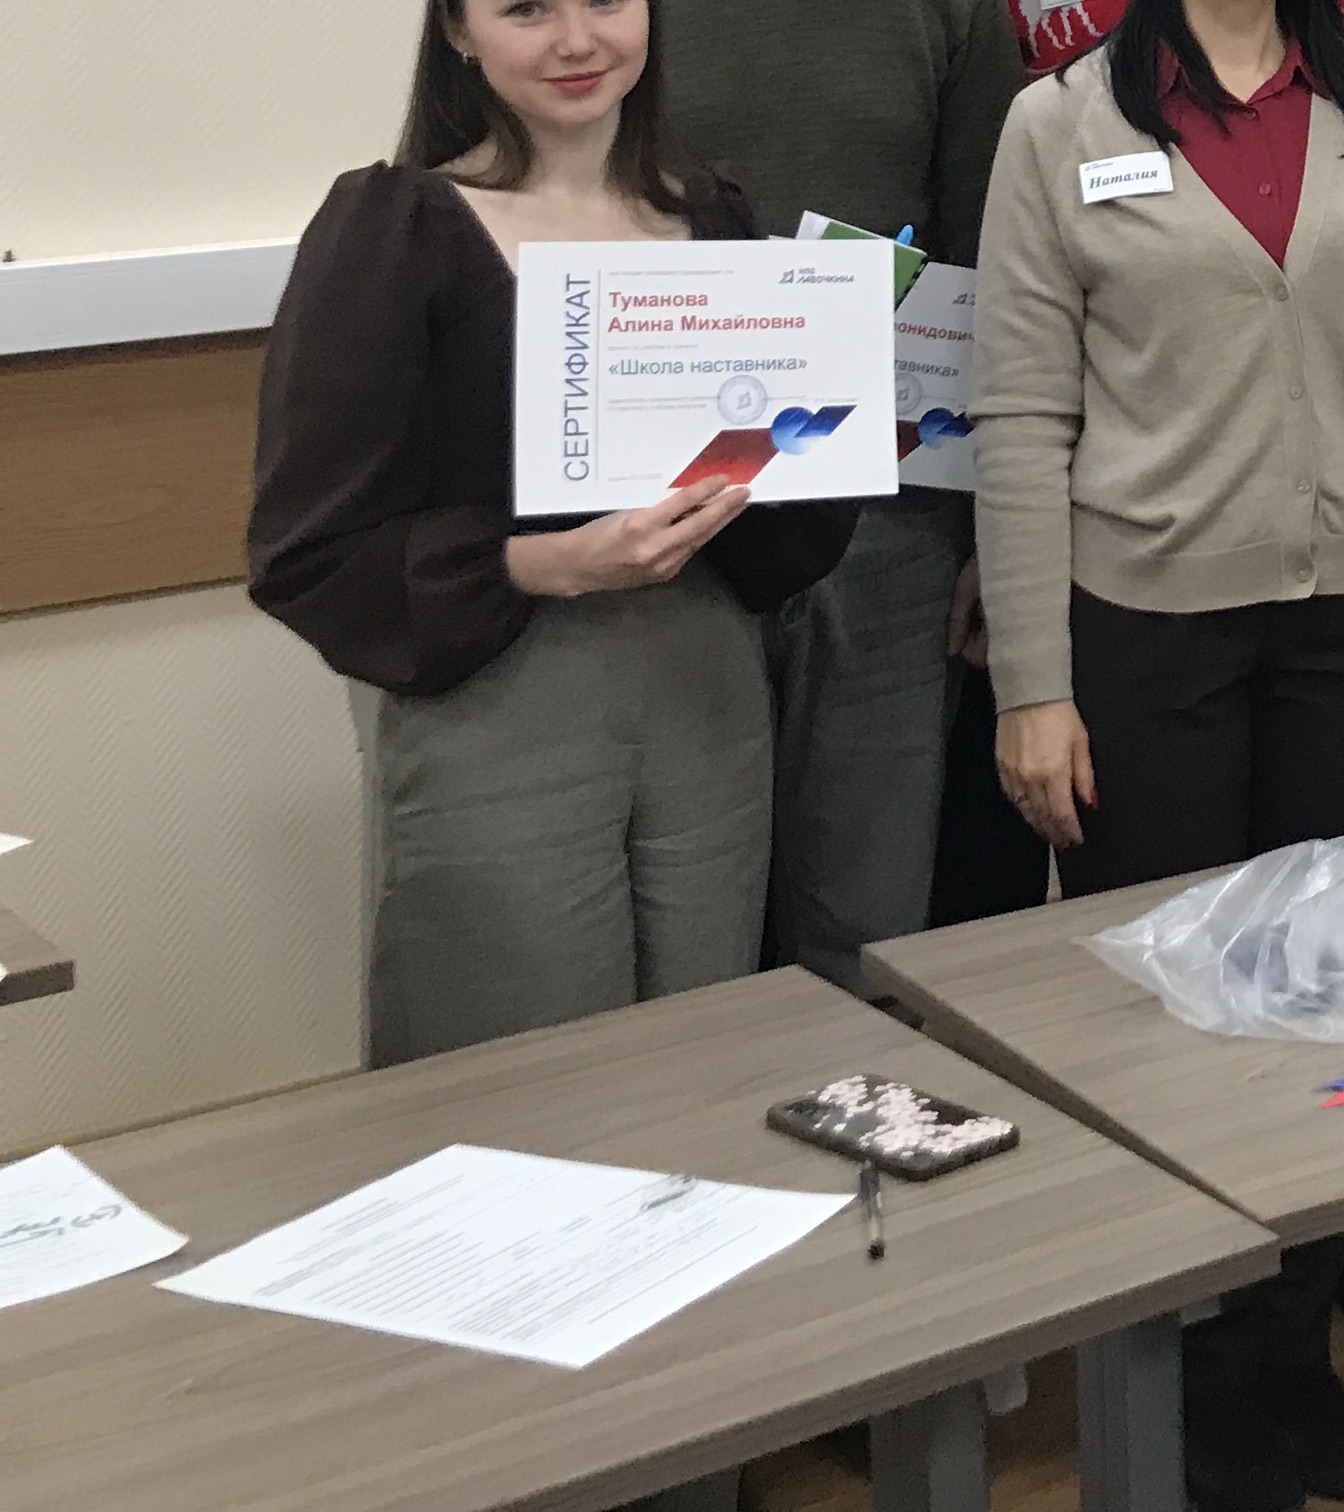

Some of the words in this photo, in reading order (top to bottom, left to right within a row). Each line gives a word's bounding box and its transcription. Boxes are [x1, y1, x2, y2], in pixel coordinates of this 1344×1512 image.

[609, 291, 709, 310] Туманова
[608, 315, 675, 333] Алина
[680, 313, 806, 332] Михайловна
[608, 357, 684, 377] «Школа
[691, 355, 808, 374] наставника»
[563, 273, 592, 482] СЕРТИФИКАТ
